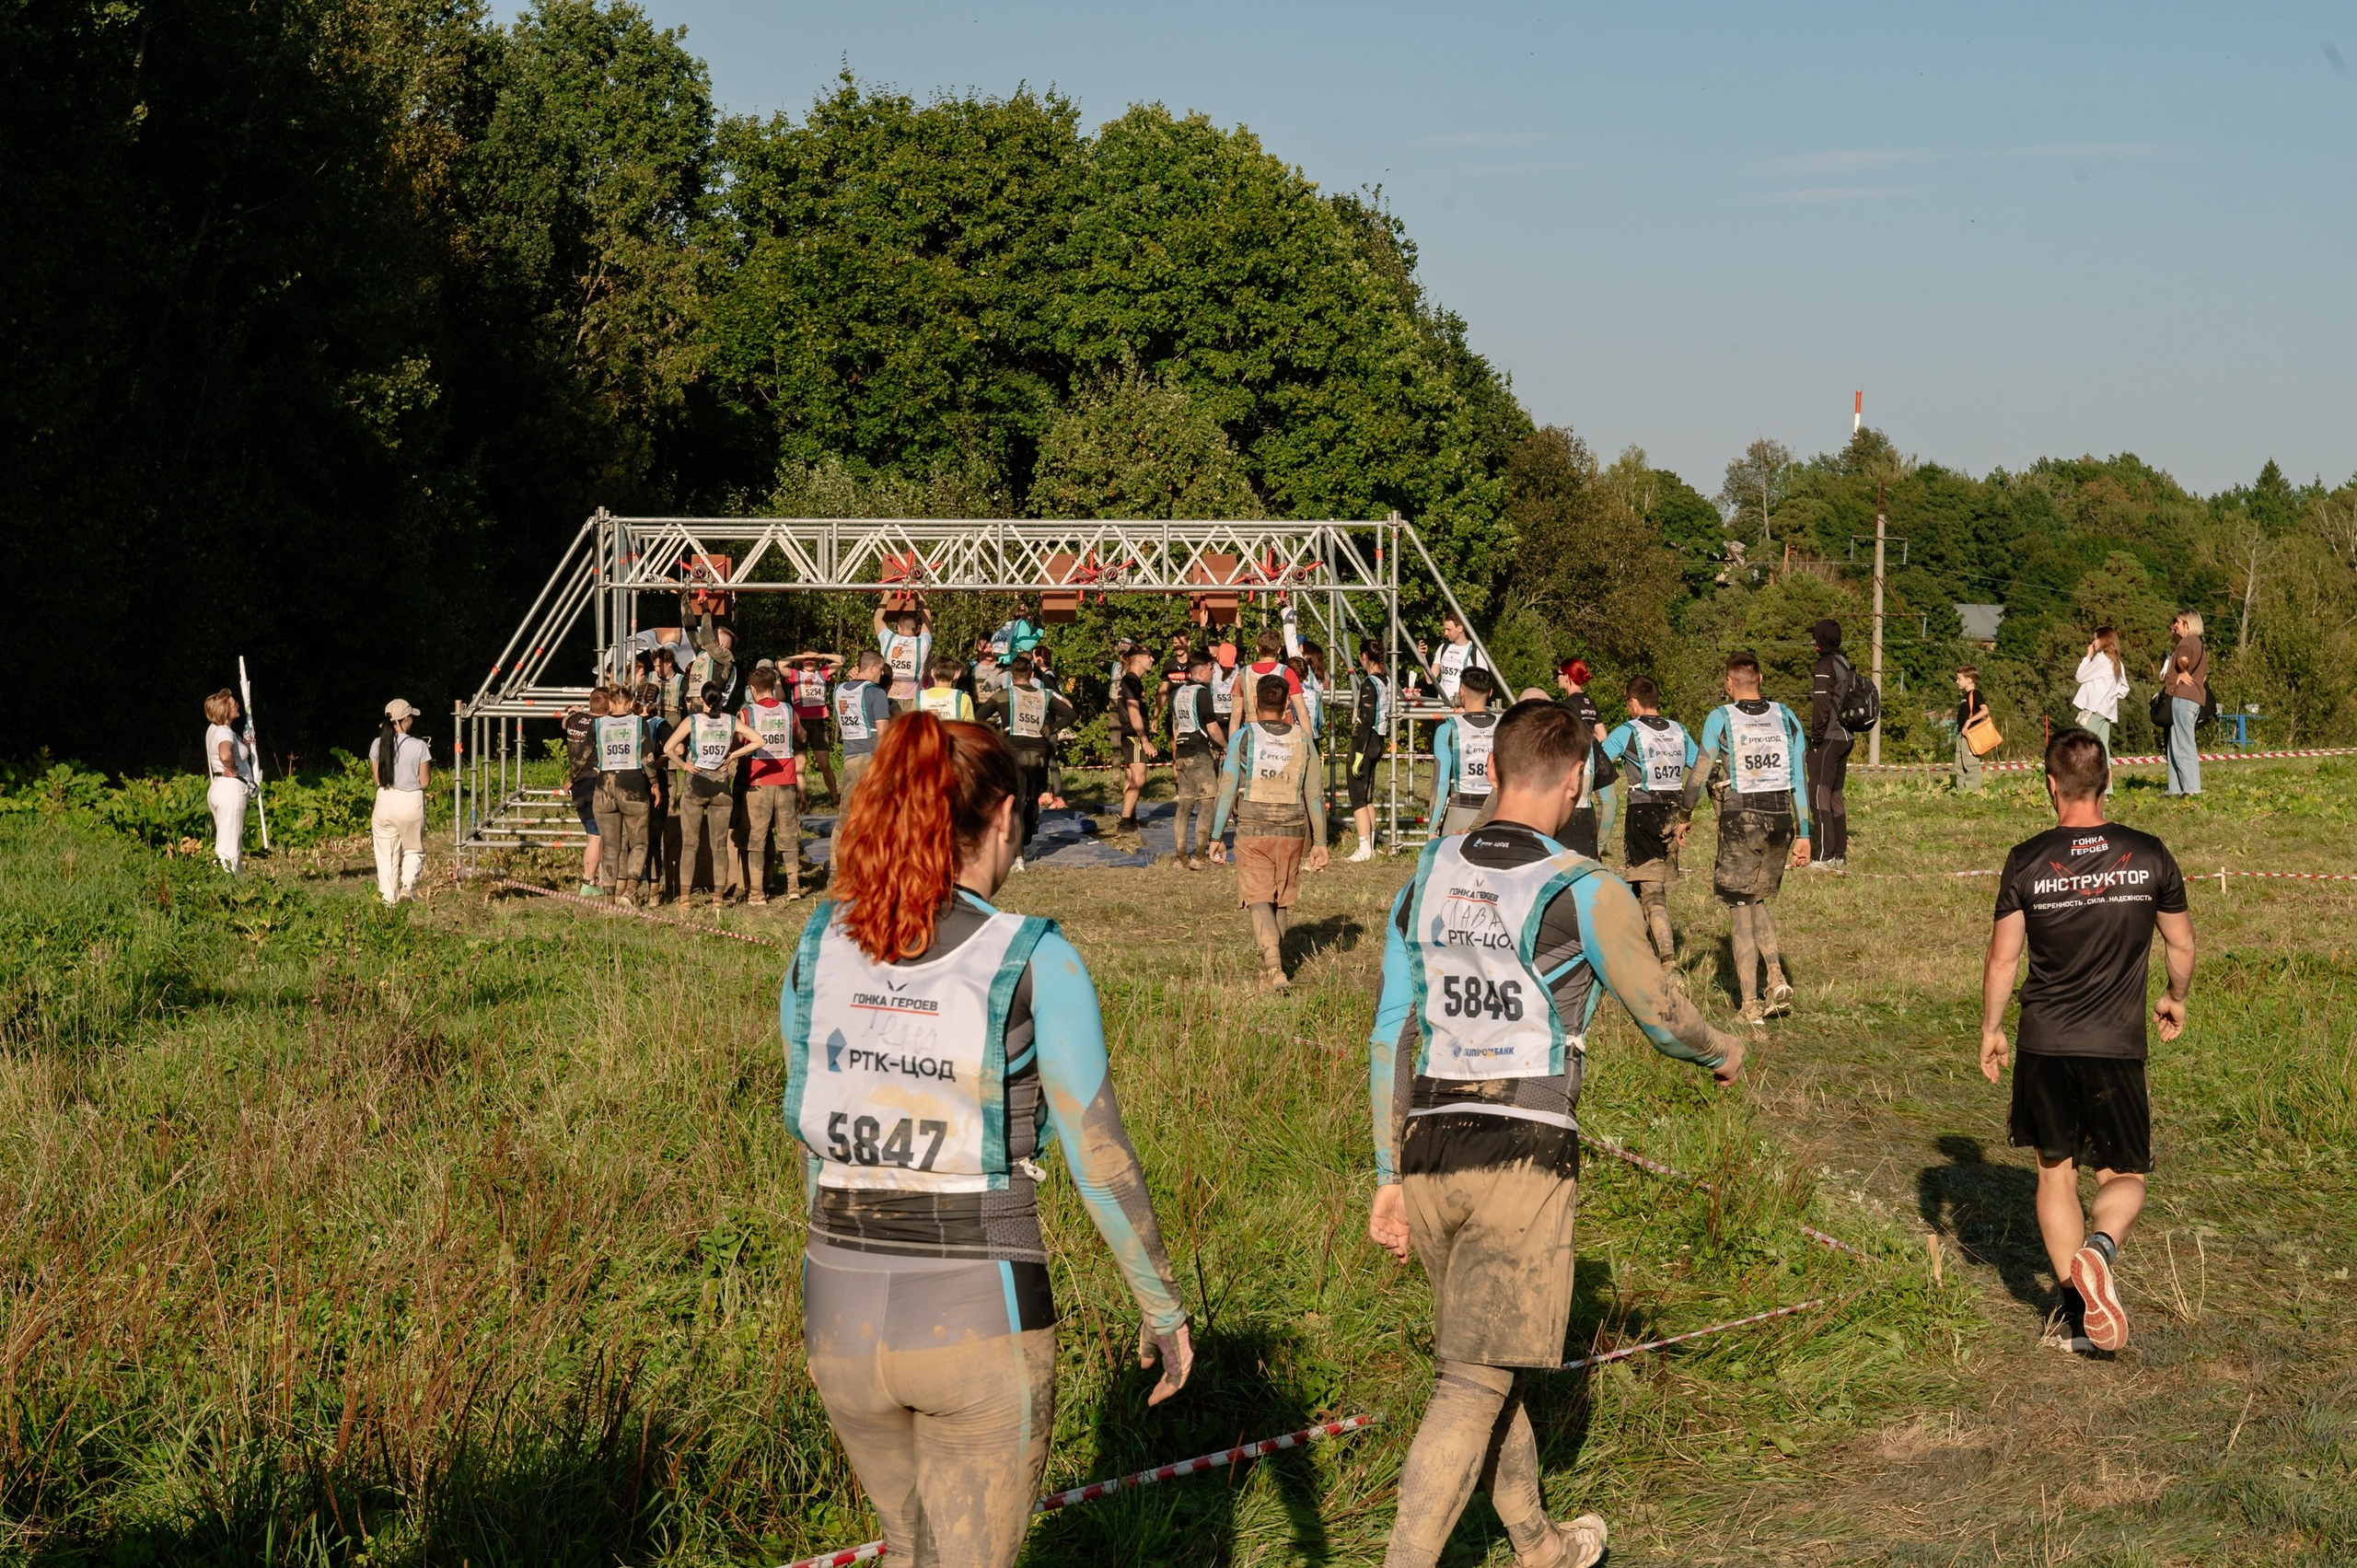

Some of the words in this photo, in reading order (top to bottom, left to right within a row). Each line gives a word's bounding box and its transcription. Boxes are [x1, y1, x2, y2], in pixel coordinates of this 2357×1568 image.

[891, 659, 911, 669] 5256
[806, 688, 821, 696] 5254
[1217, 693, 1232, 702] 553
[841, 715, 860, 726] 5252
[1019, 713, 1040, 725] 5554
[762, 734, 785, 744] 5060
[1749, 736, 1782, 744] РТК-ЦОД
[607, 744, 631, 755] 5056
[702, 745, 726, 755] 5057
[1267, 754, 1292, 762] РТК-ЦО
[1745, 753, 1782, 770] 5842
[1468, 762, 1488, 776] 58
[2073, 835, 2105, 845] ГОНКА
[2071, 843, 2109, 855] ГЕРОЕВ
[2034, 870, 2150, 895] ИНСТРУКТОР
[1449, 888, 1475, 900] ГОНКА
[2108, 895, 2153, 903] НАДЕЖНОСТЬ
[1448, 930, 1515, 950] РТК-ЦО
[853, 993, 887, 1006] ГОНКА
[890, 997, 938, 1011] ГЕРОЕВ
[1444, 976, 1524, 1022] 5846
[849, 1049, 957, 1083] РТК-ЦОД
[827, 1111, 948, 1171] 5847
